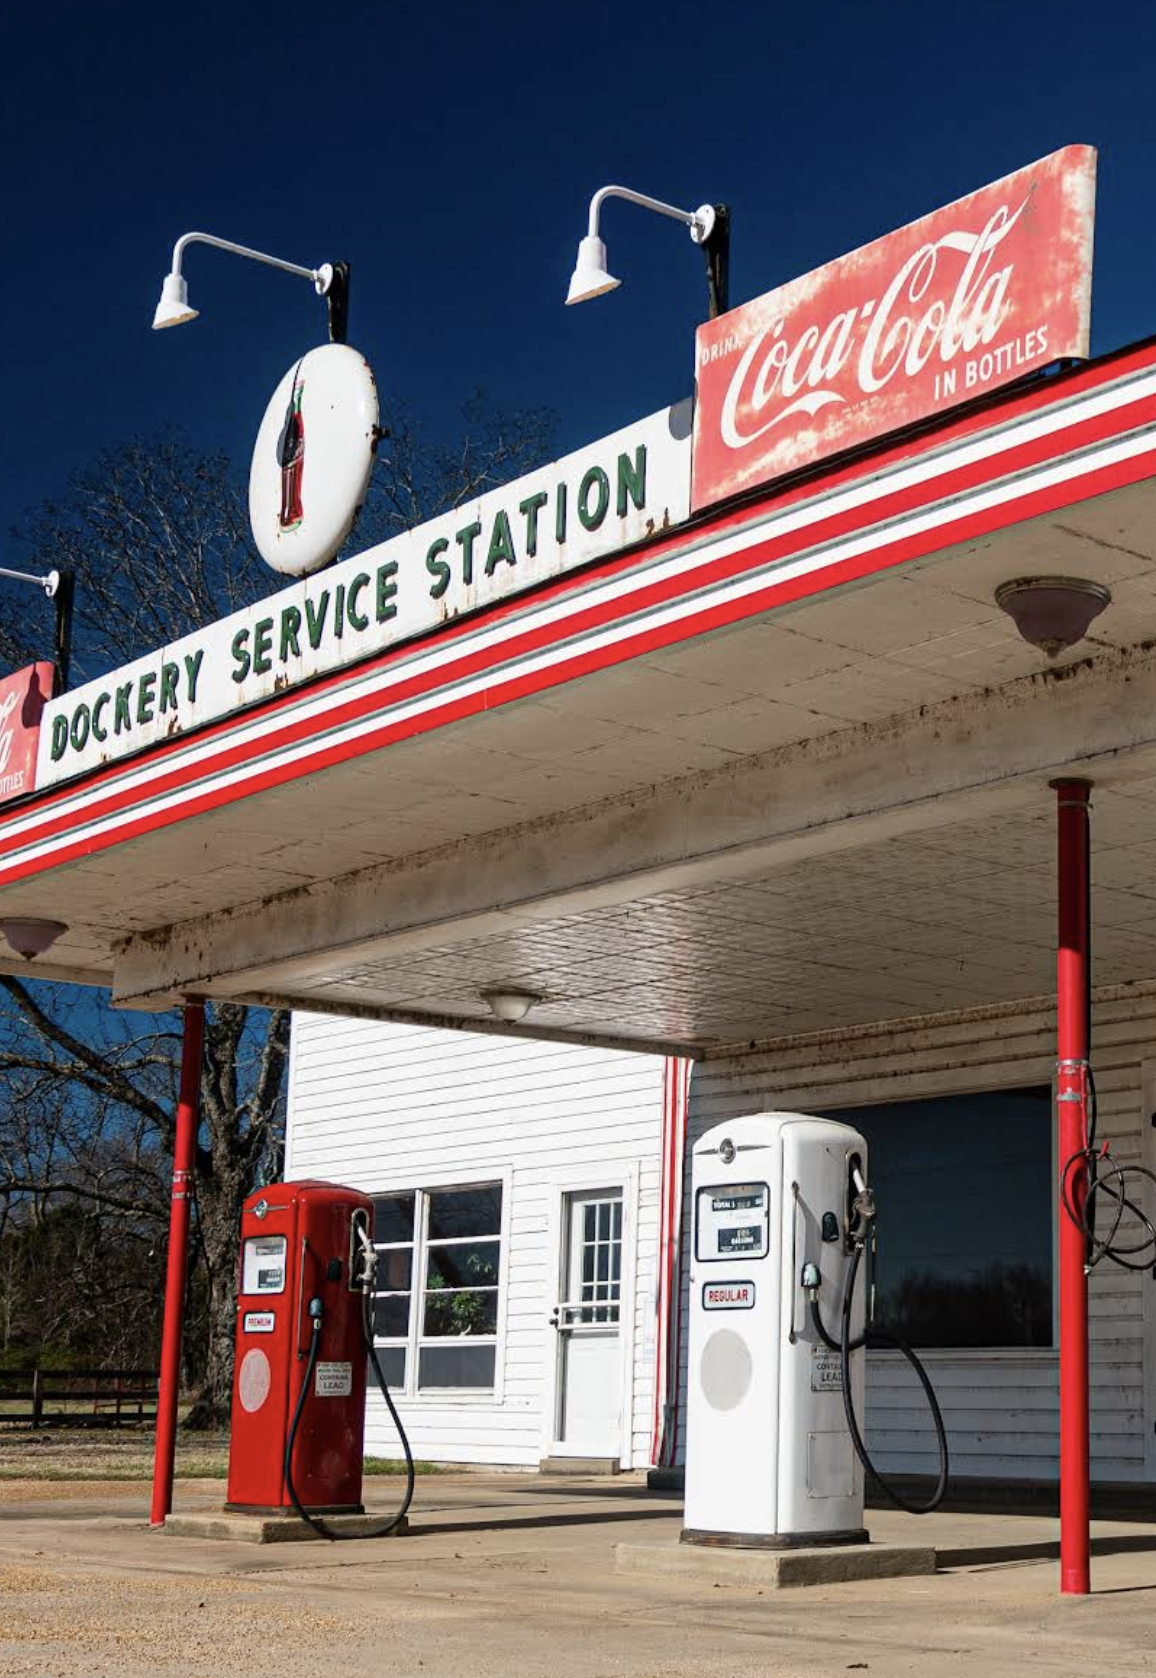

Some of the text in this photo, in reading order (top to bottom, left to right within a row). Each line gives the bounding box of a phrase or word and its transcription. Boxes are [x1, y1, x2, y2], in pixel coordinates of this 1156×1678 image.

[721, 188, 1037, 450] Coca-Cola
[934, 323, 1048, 401] IN BOTTLES
[51, 648, 204, 762] DOCKERY
[231, 560, 398, 683] SERVICE
[425, 444, 647, 599] STATION
[0, 769, 24, 794] TTLES
[708, 1289, 748, 1302] REGULAR
[248, 1317, 271, 1327] PREMIUM
